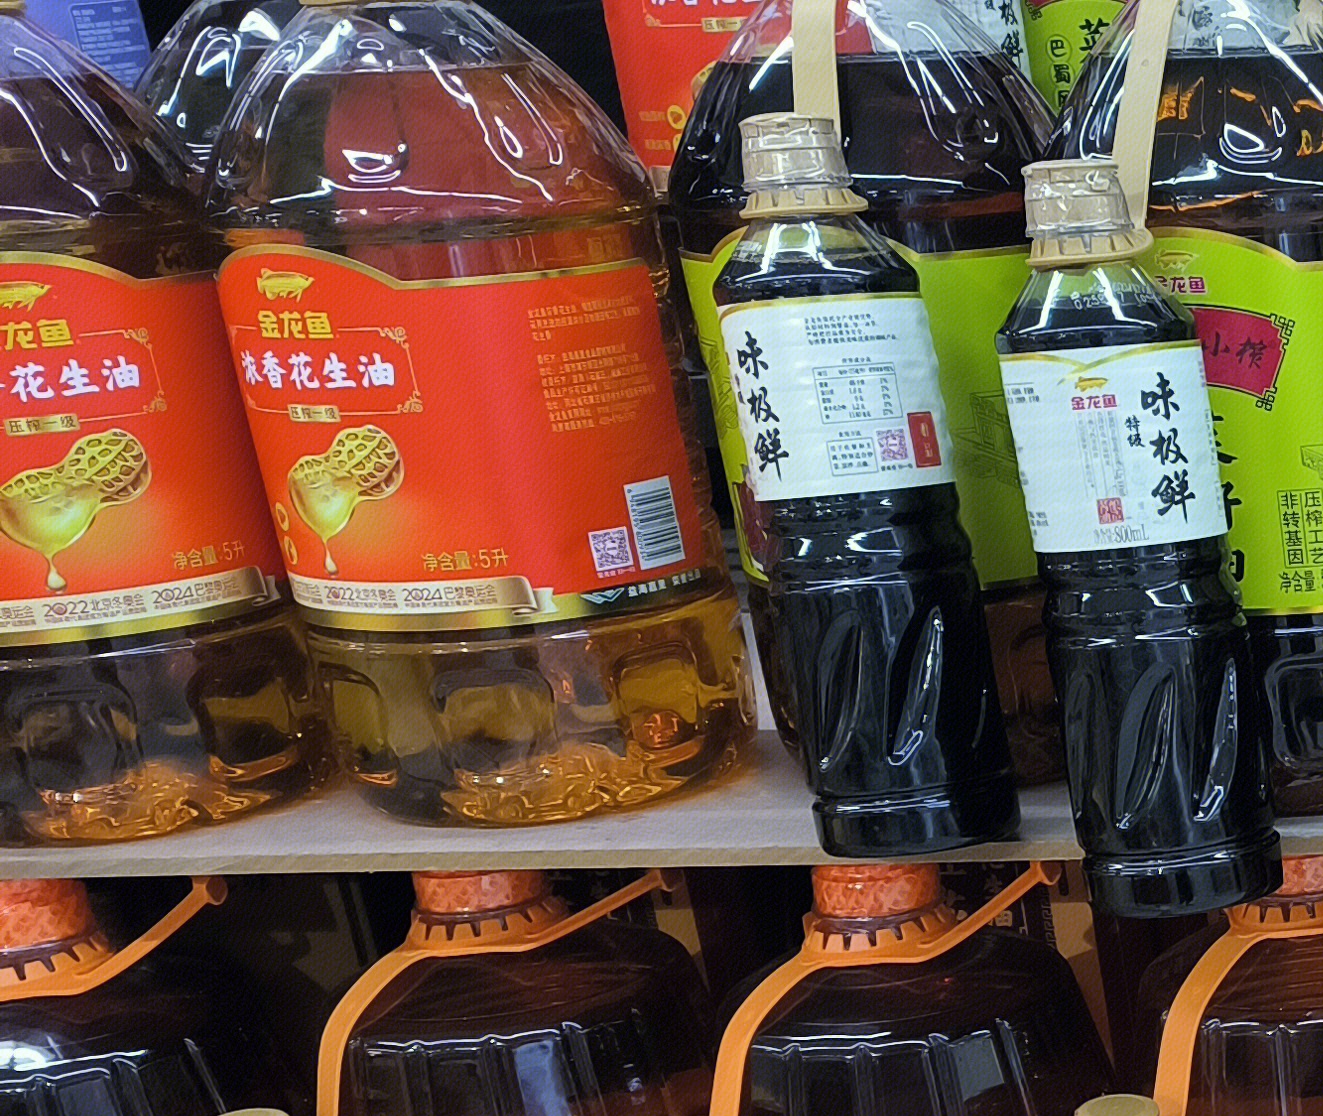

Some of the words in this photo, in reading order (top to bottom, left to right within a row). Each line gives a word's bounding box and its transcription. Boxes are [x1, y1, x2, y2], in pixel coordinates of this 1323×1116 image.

[0, 318, 74, 351] 龙鱼
[257, 310, 335, 340] 金龙鱼
[0, 355, 141, 402] 花生油
[240, 350, 395, 389] 浓香花生油
[736, 330, 790, 483] 味极鲜
[1071, 394, 1118, 411] 金龙鱼
[1125, 415, 1146, 448] 特级
[1141, 372, 1196, 524] 味极鲜
[1281, 493, 1304, 566] 非转基因
[422, 548, 509, 572] 净含量:5升
